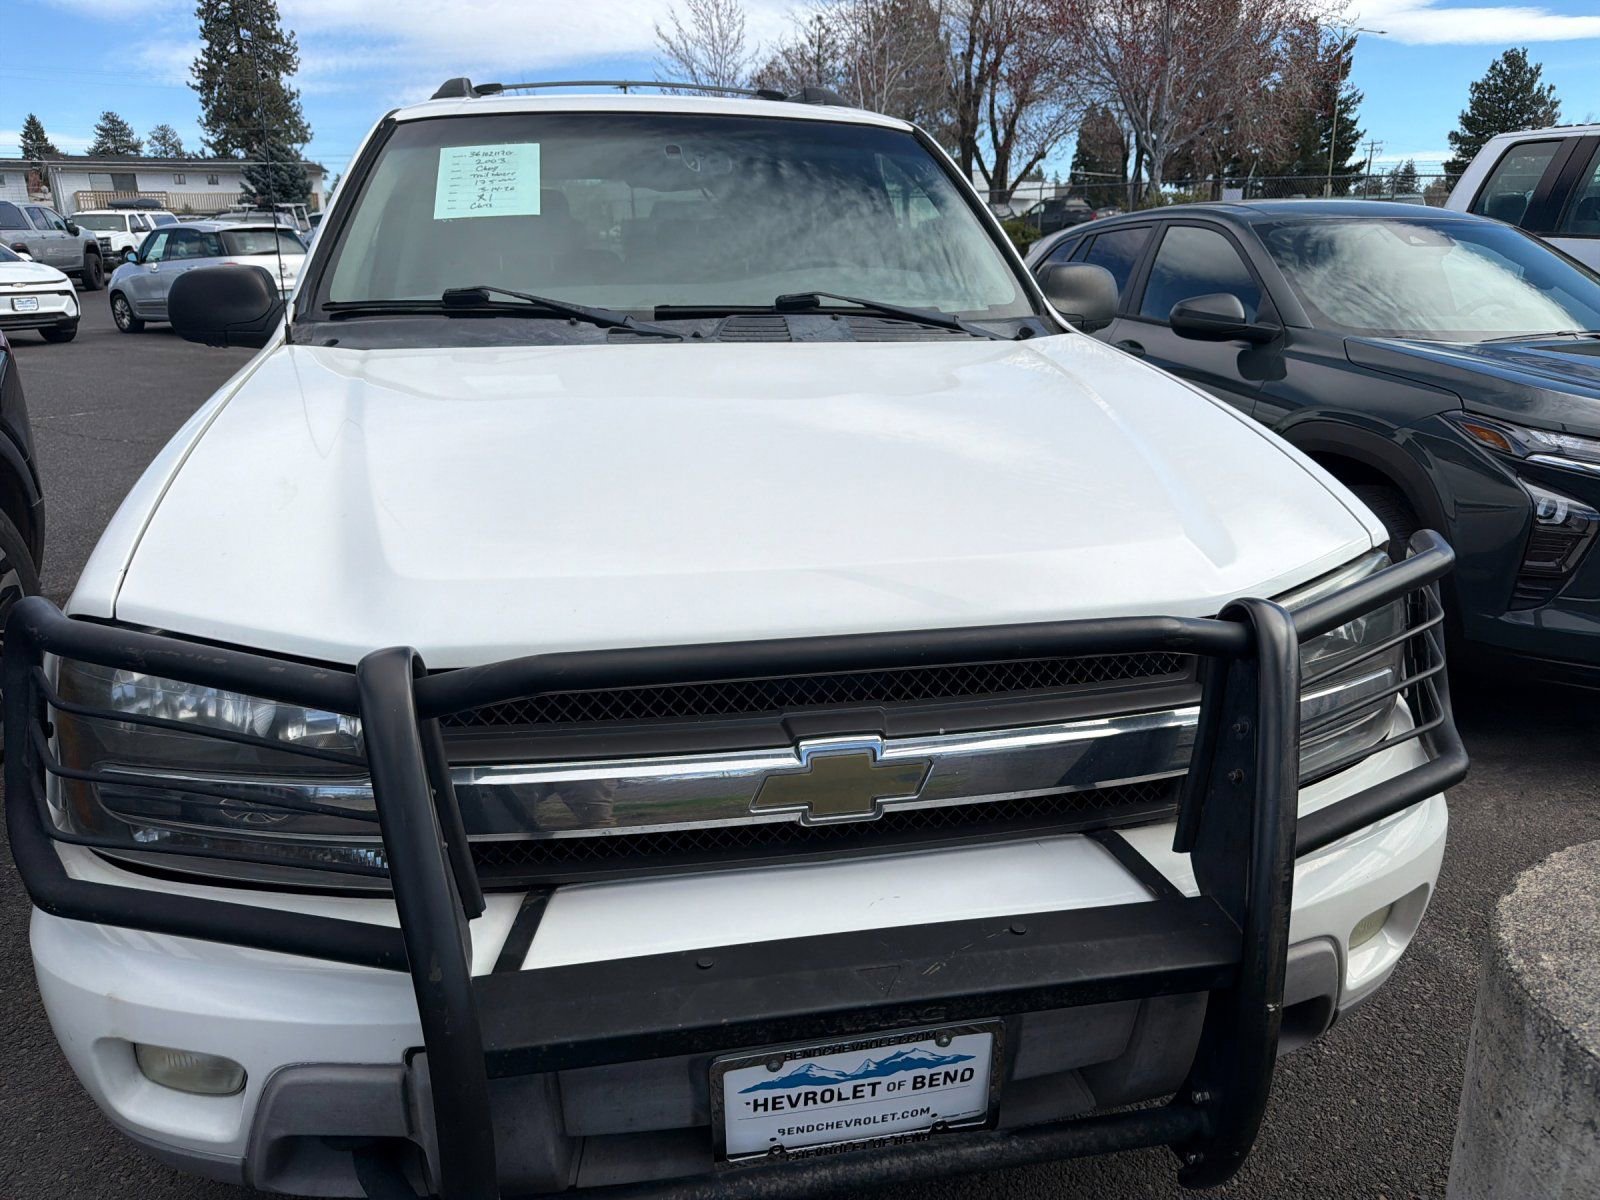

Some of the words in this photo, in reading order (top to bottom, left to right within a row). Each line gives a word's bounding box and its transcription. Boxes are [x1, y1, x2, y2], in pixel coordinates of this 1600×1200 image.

[745, 1081, 881, 1112] HEVROLET
[887, 1080, 907, 1093] OF
[912, 1067, 975, 1091] BEND
[778, 1107, 931, 1136] BENDCHEVROLET.COM
